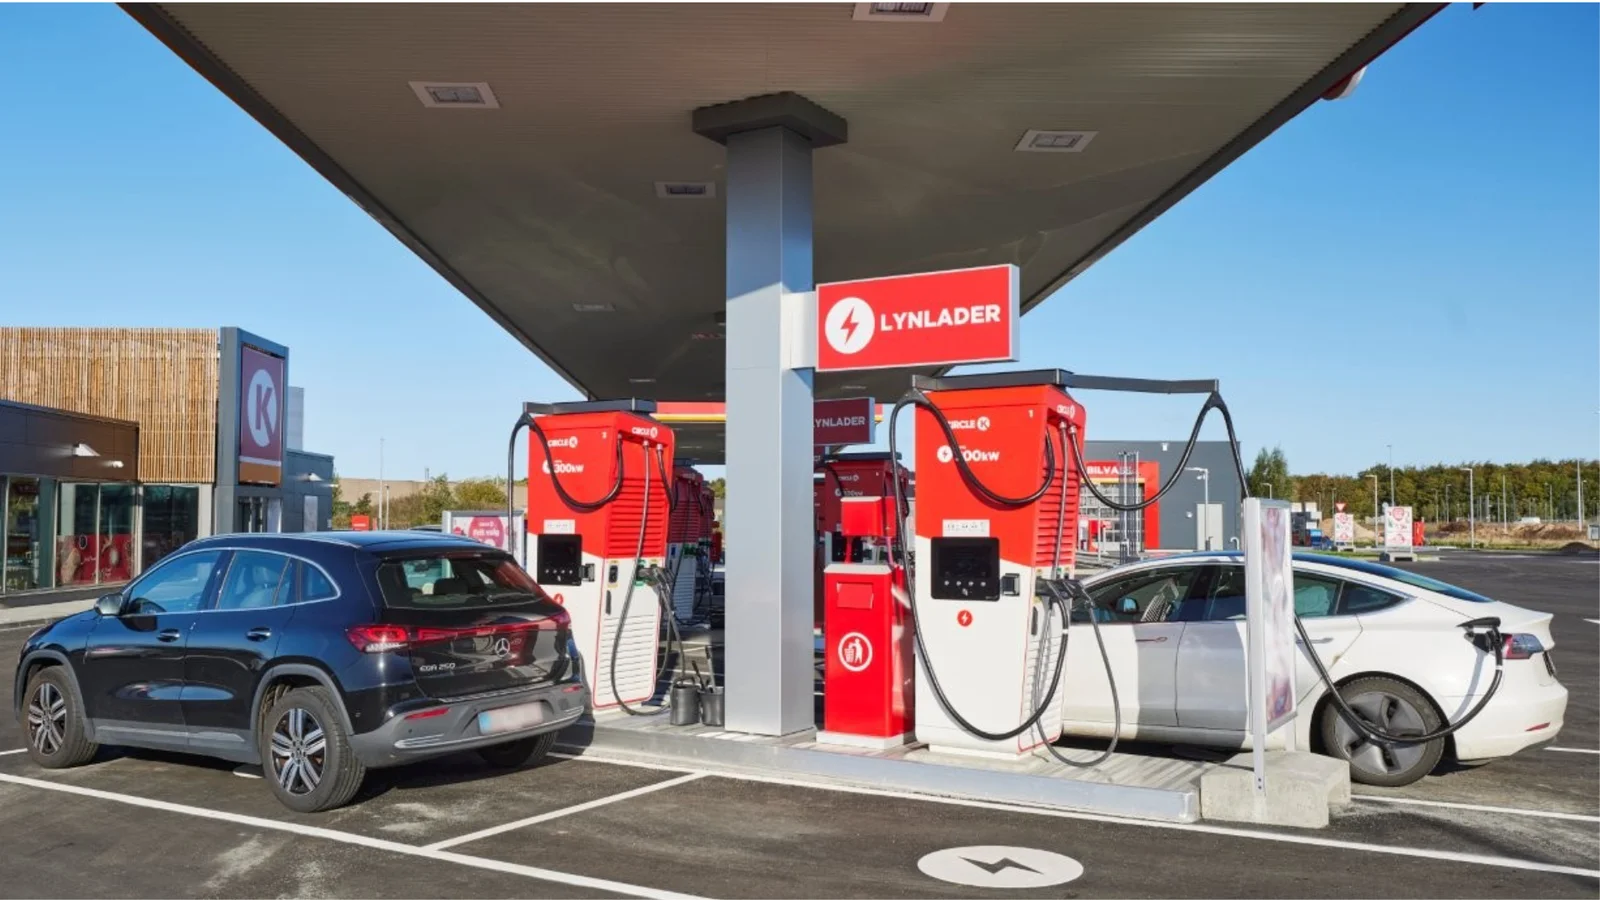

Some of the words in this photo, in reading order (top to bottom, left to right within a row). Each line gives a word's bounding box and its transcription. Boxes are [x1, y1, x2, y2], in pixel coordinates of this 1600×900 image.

[880, 304, 1001, 332] LYNLADER
[253, 381, 275, 443] K
[813, 416, 866, 429] YNLADER
[956, 449, 1000, 462] 00kW
